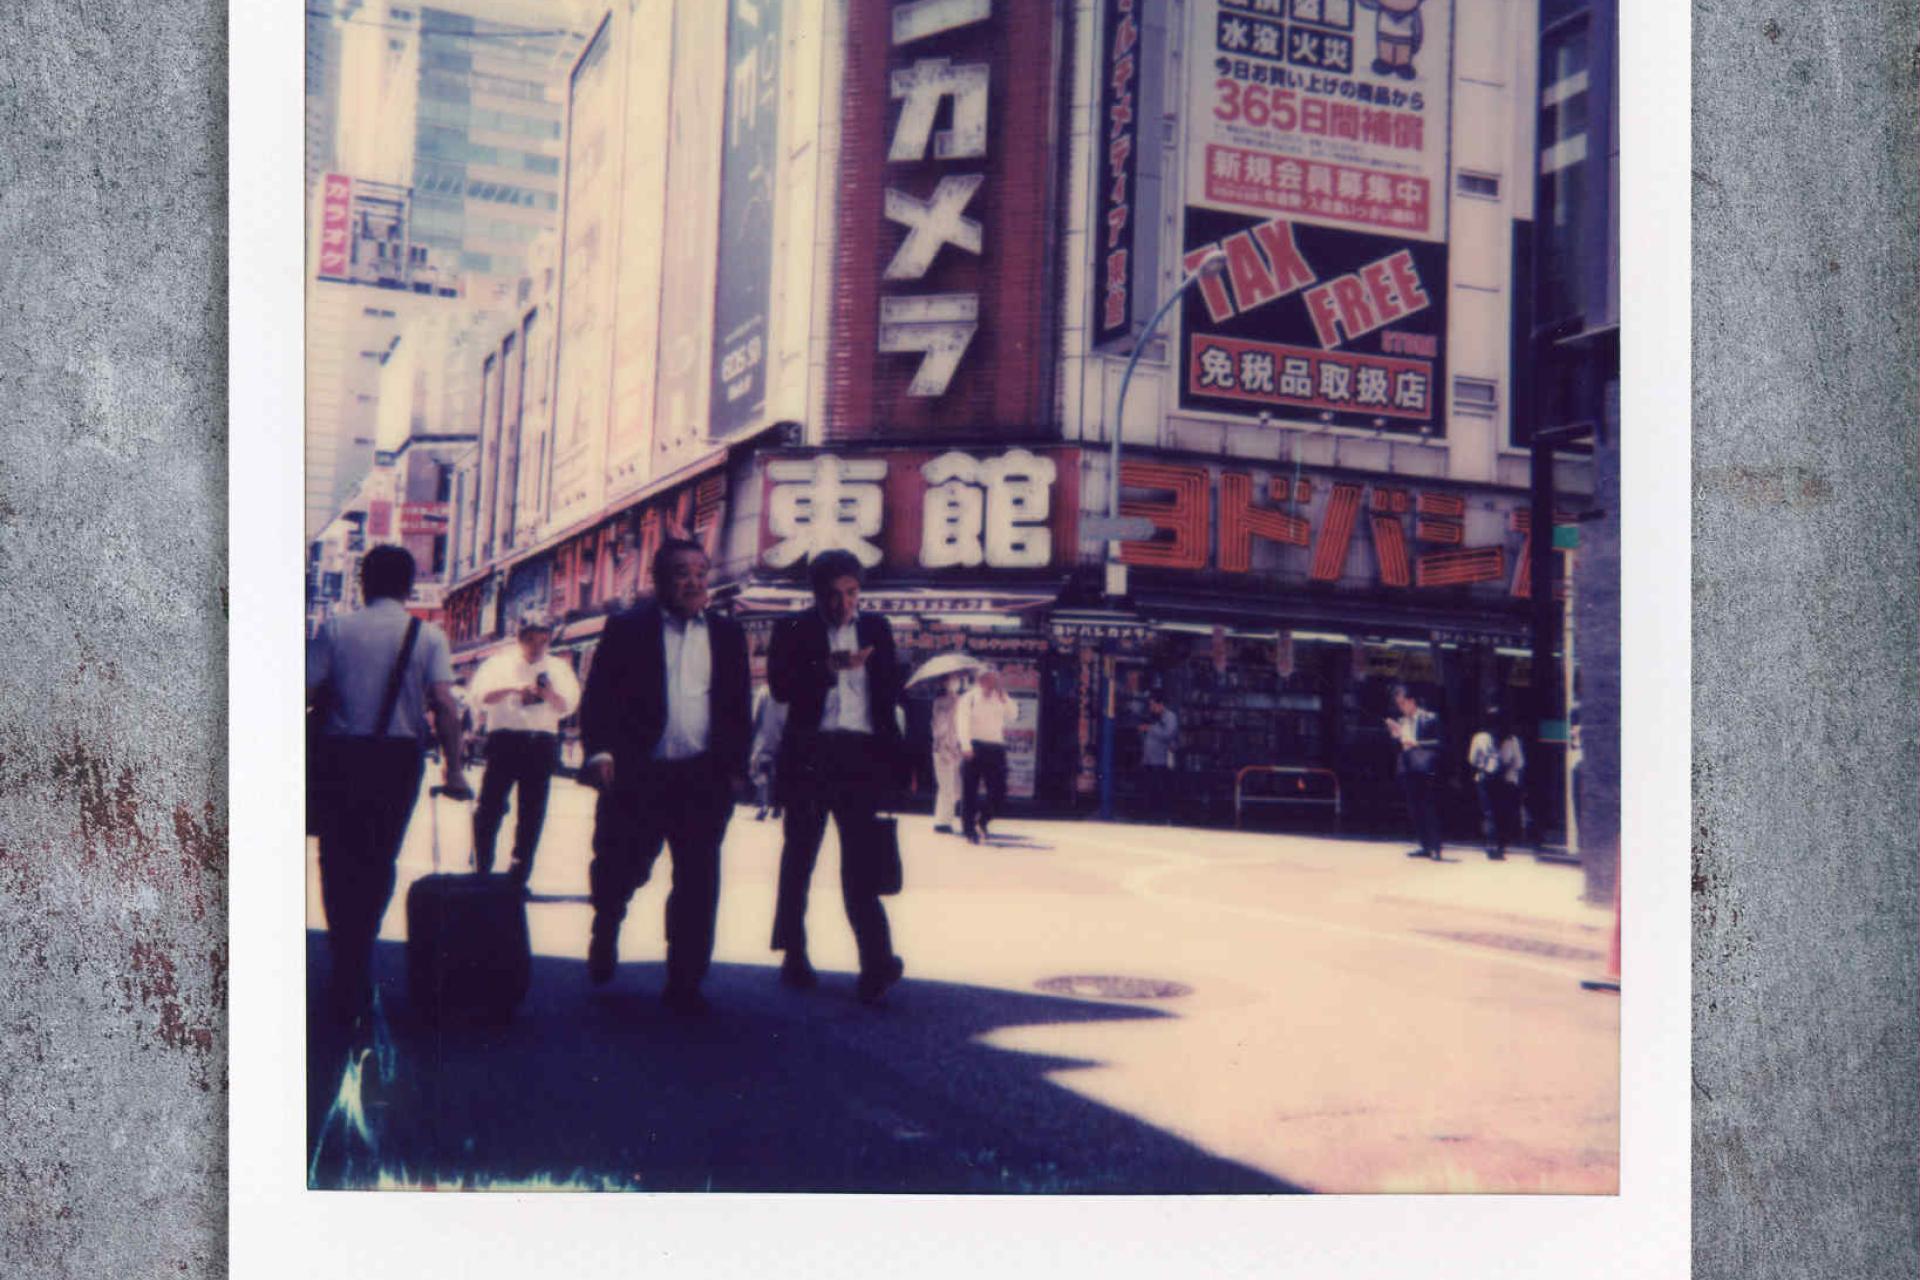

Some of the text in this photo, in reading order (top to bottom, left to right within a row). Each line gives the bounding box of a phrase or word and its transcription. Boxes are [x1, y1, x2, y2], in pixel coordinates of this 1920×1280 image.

[1214, 56, 1425, 111] 今日お買い上げの商品から
[1292, 31, 1349, 69] 火災
[1213, 77, 1425, 151] 365日間補償
[1212, 149, 1423, 209] 新規会員募集中
[1183, 215, 1317, 323] TAX
[1302, 249, 1430, 351] FREE
[1200, 347, 1427, 409] 免税品取扱店
[763, 448, 1057, 569] 東館
